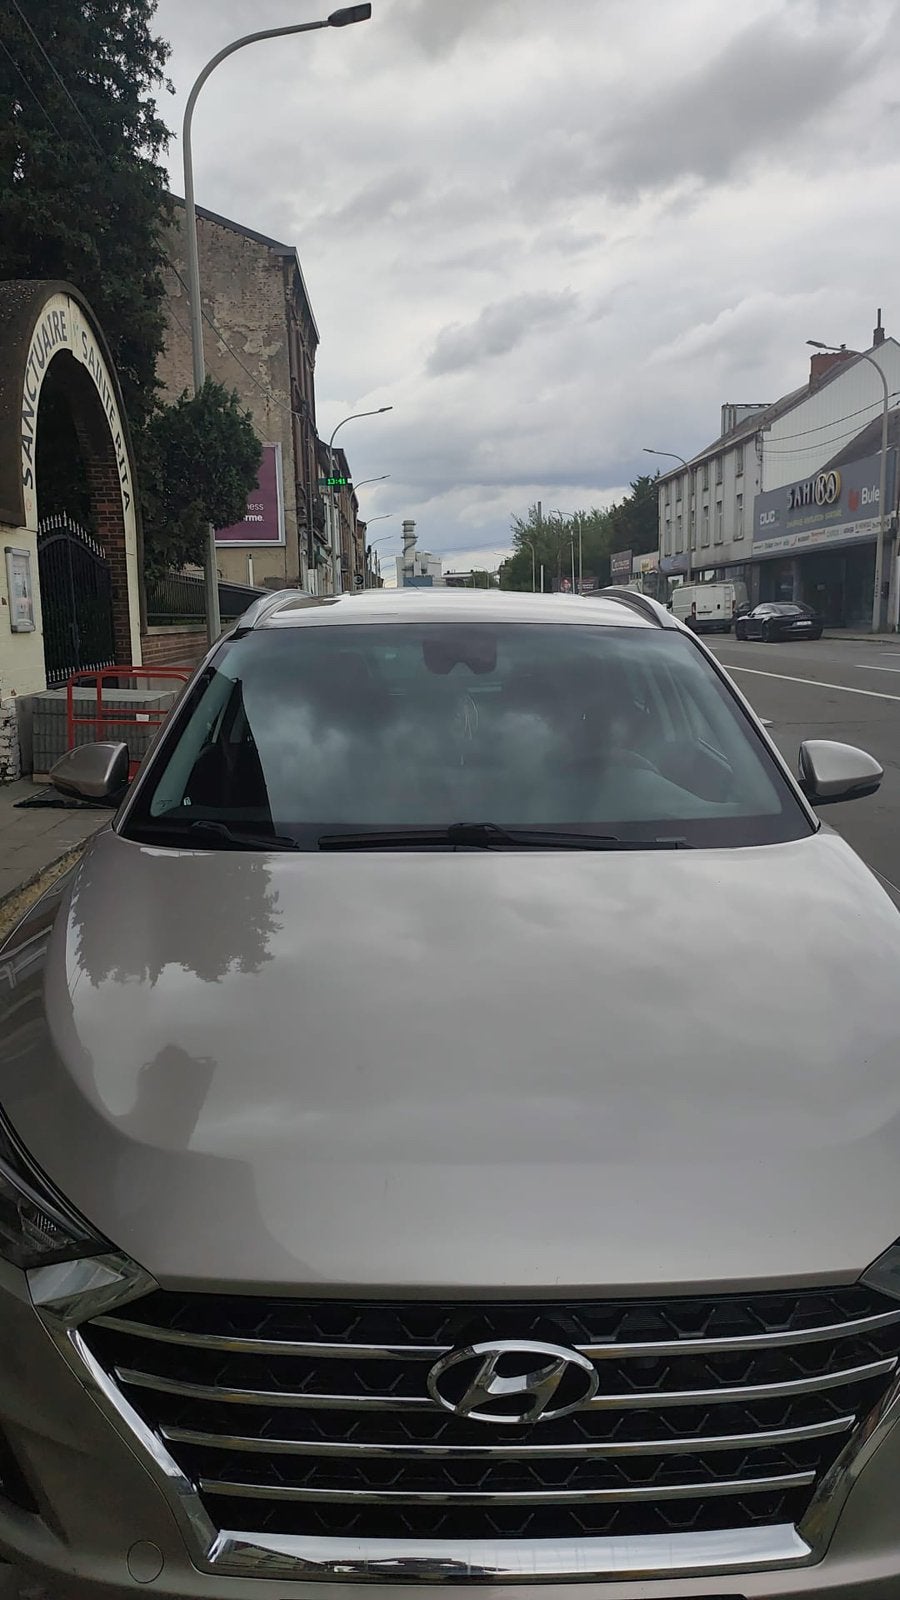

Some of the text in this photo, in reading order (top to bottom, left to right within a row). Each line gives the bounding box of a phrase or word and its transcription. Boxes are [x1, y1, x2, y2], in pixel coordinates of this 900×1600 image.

[21, 310, 131, 511] SANCTUAIRE SAINTE RITA
[861, 485, 880, 505] Bule
[243, 514, 264, 522] rme.
